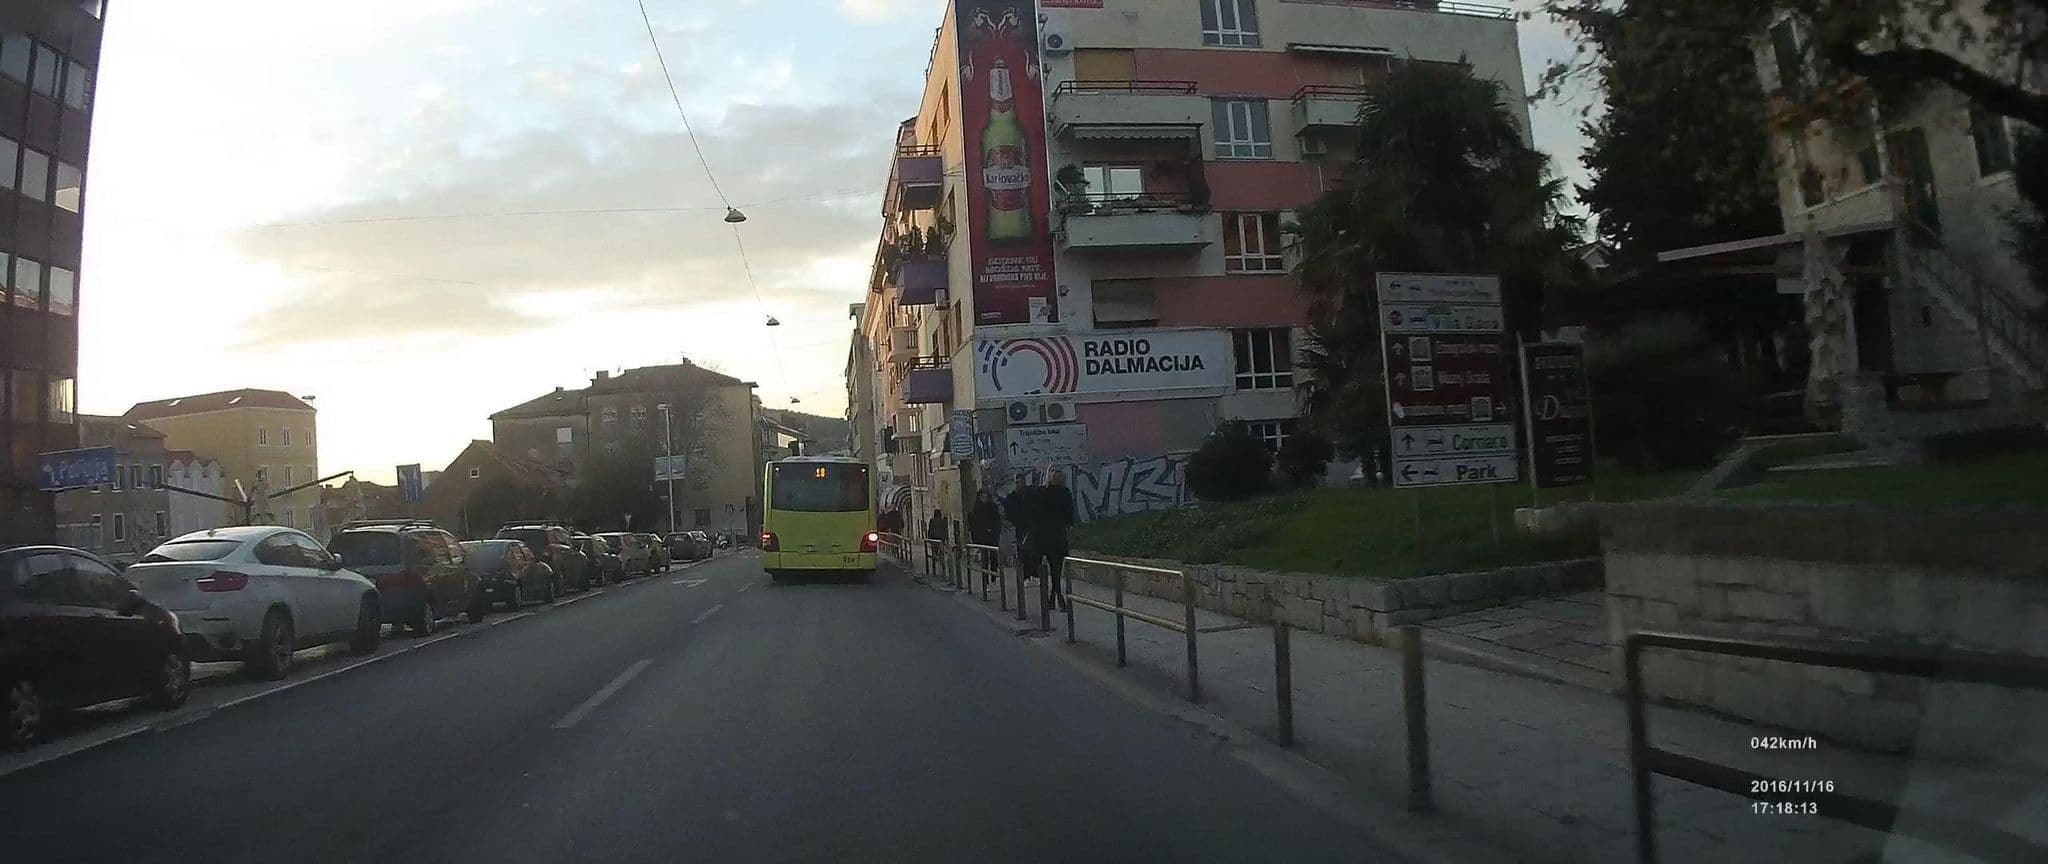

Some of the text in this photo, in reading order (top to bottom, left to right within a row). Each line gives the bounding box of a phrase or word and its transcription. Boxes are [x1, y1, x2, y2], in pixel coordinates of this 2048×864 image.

[1084, 340, 1151, 358] RADIO
[1086, 355, 1206, 376] DALMACIJA
[1456, 463, 1497, 480] Park
